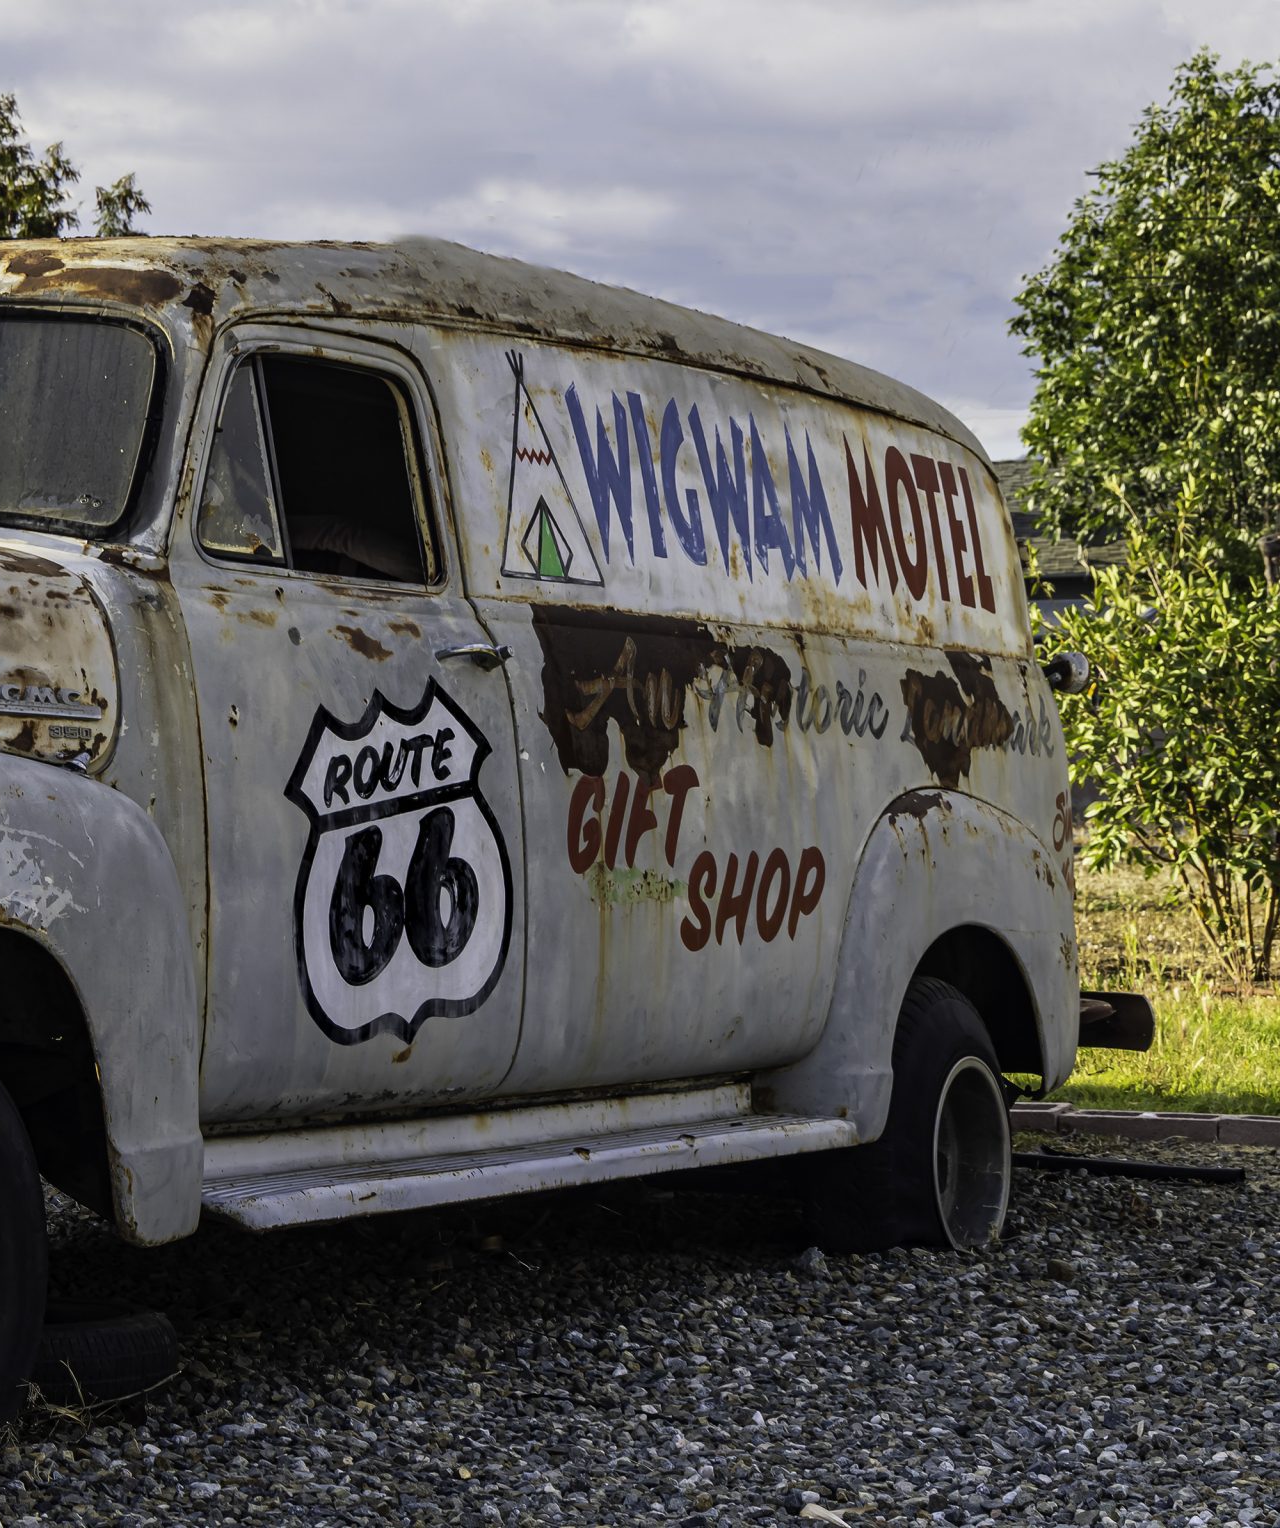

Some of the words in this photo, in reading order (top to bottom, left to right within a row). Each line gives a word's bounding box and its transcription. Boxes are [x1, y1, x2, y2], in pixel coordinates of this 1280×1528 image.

[564, 381, 844, 588] WIGWAM
[842, 431, 997, 614] MOTEL
[48, 725, 93, 740] 350
[323, 726, 456, 809] ROUTE
[566, 764, 701, 875] GIFT
[328, 805, 480, 987] 66
[680, 845, 826, 953] SHOP
